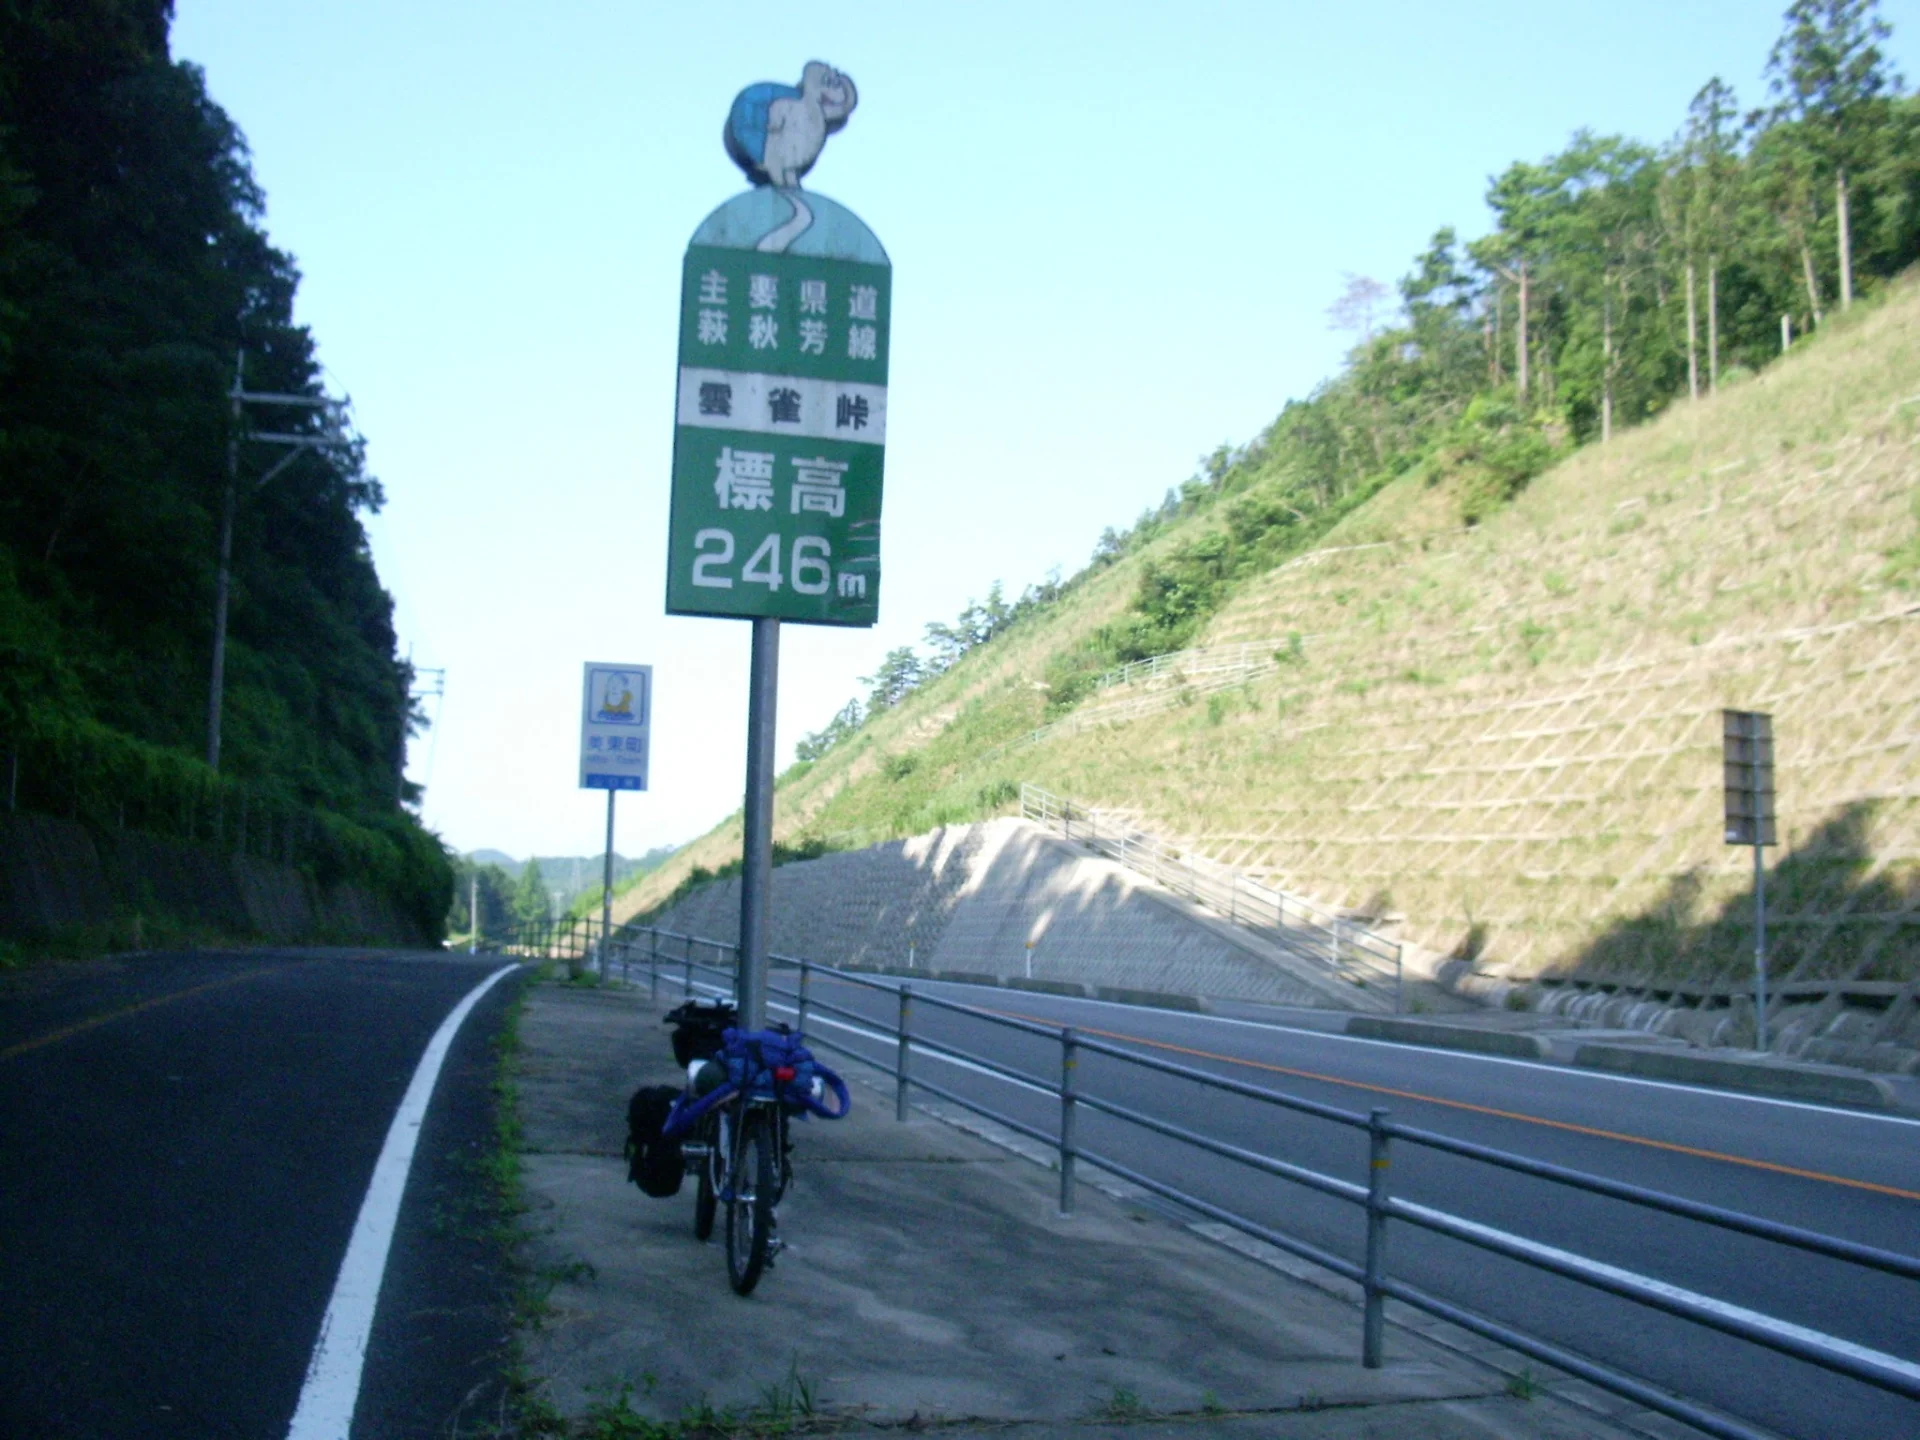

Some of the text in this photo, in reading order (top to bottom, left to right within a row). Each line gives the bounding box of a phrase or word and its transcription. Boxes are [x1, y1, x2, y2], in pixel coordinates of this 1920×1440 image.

[698, 269, 878, 321] 主要県道
[697, 308, 877, 361] 萩秋芳線
[698, 381, 869, 430] 雲雀峠
[713, 446, 849, 518] 標高
